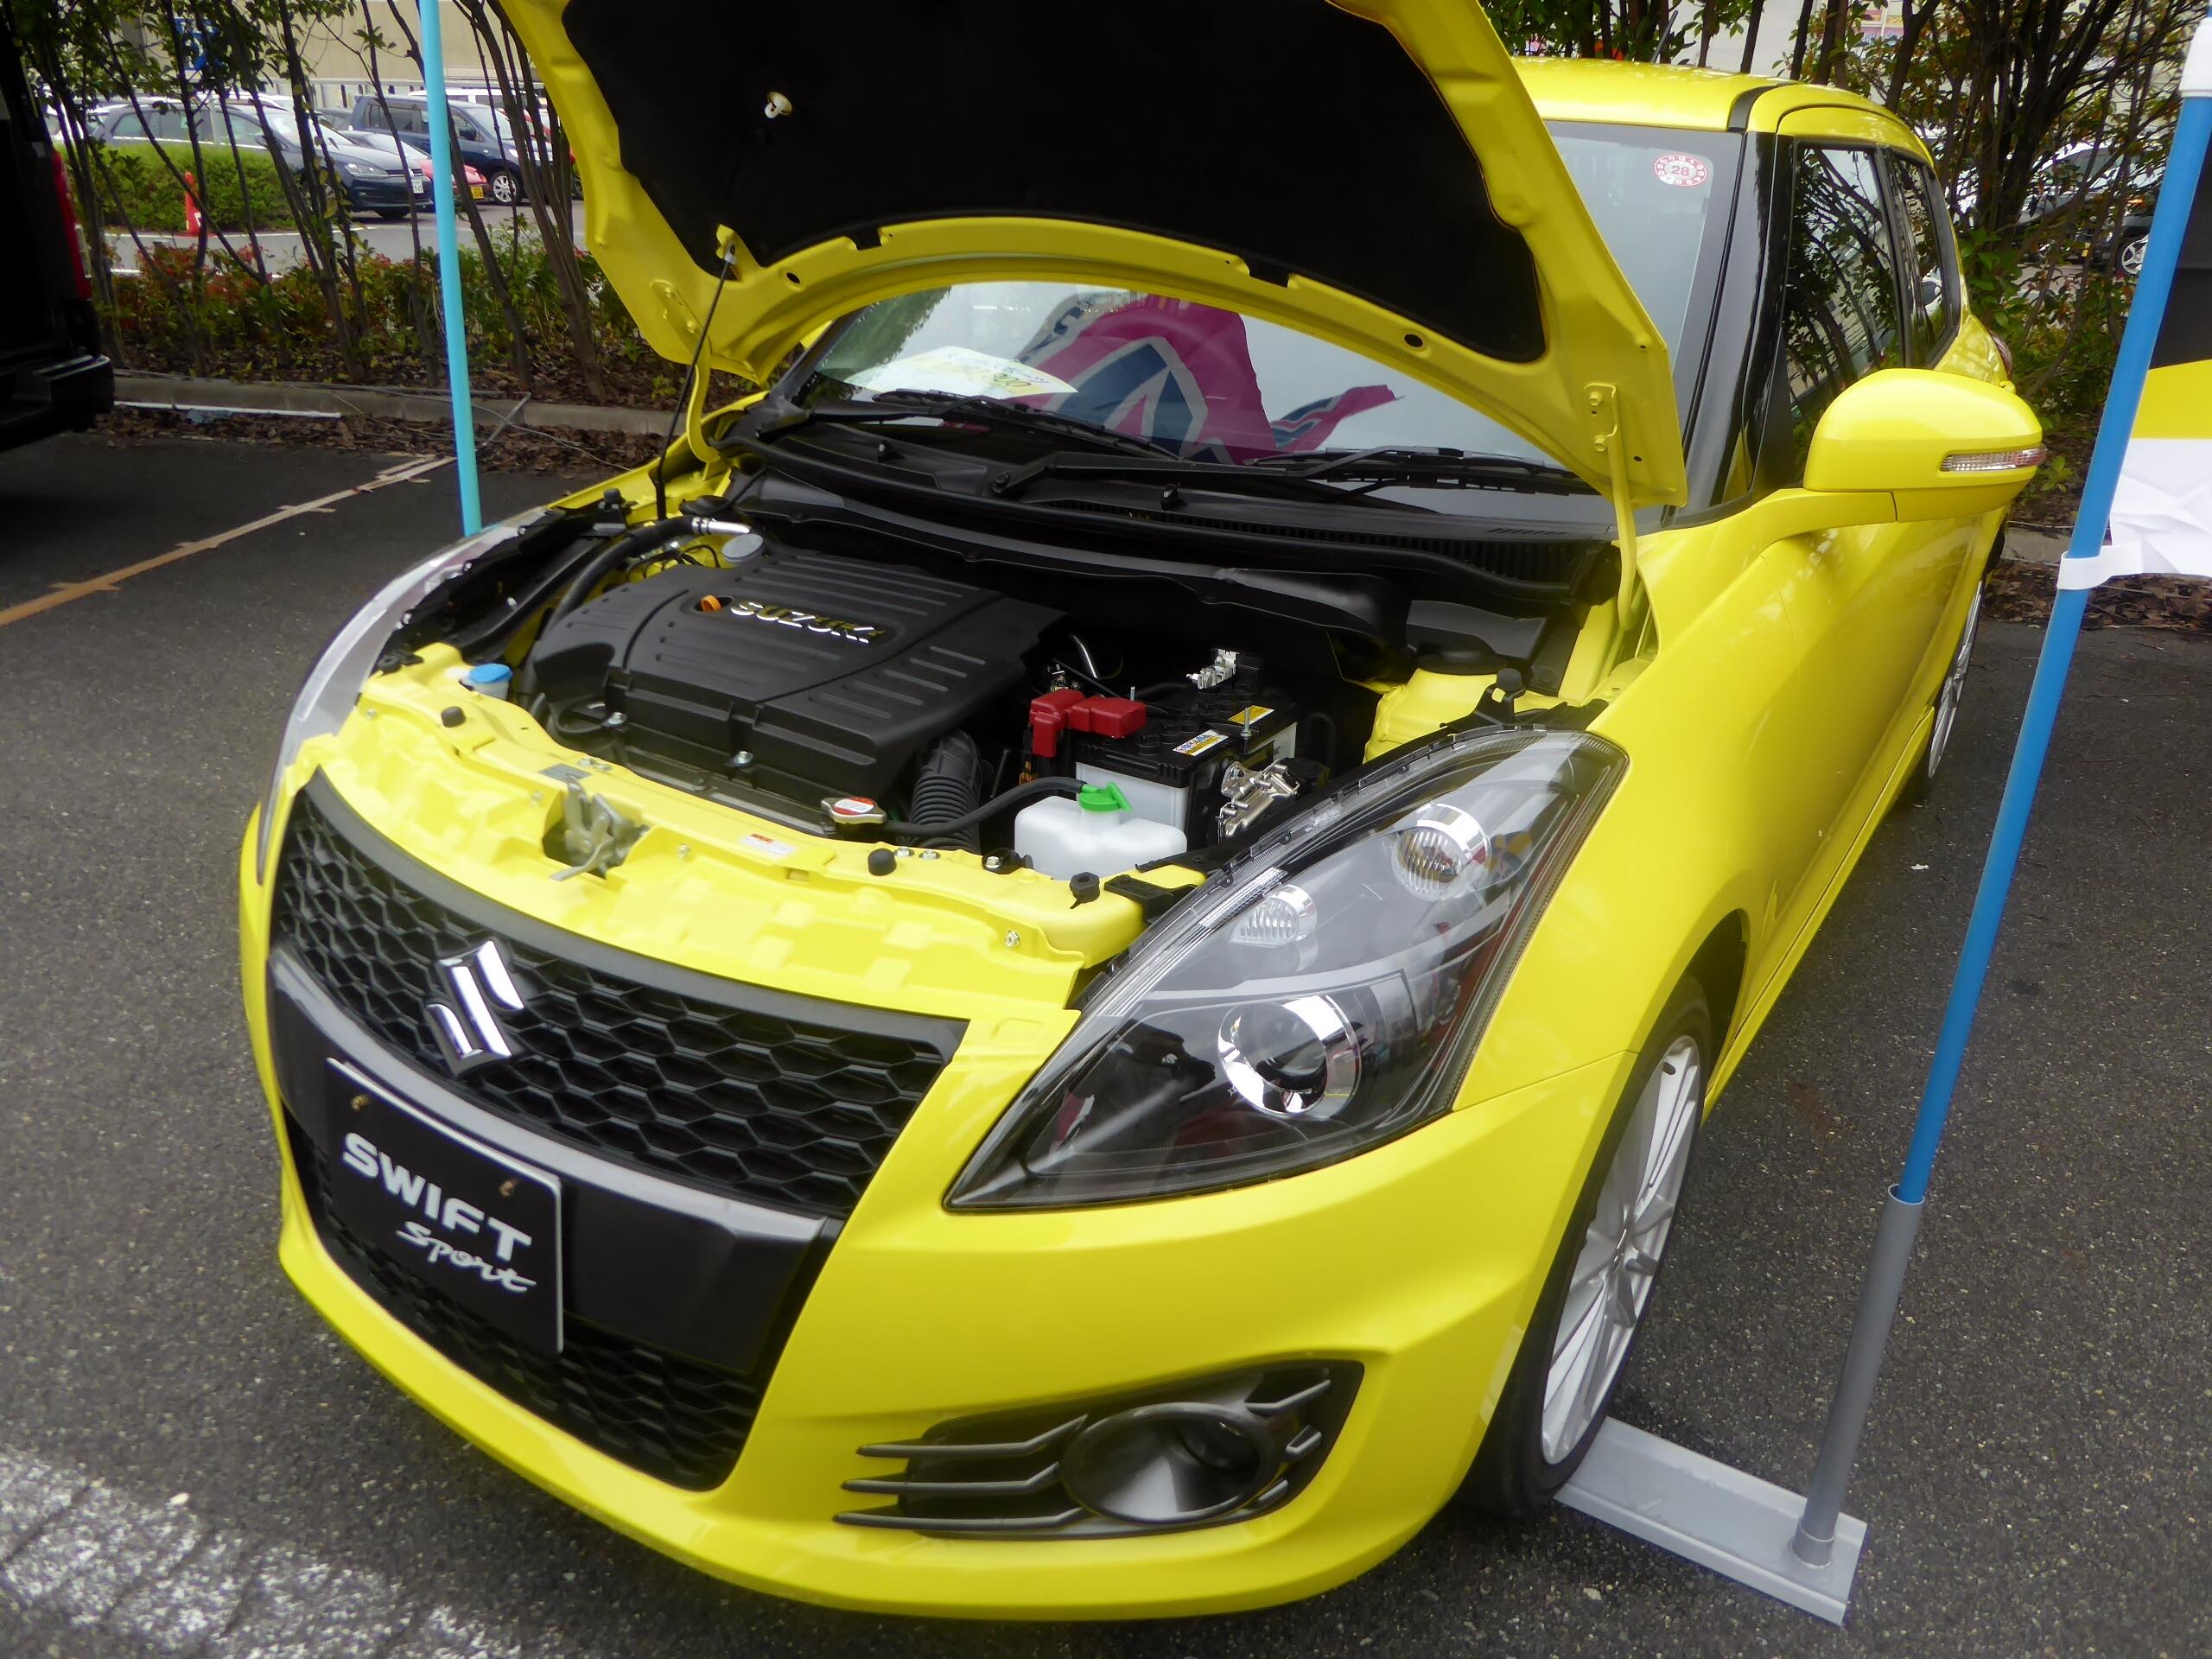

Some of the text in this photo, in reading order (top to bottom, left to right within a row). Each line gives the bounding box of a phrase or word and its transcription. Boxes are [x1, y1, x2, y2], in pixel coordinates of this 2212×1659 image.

[1671, 165, 1690, 177] 28
[730, 601, 886, 644] SUZUKI
[343, 1133, 532, 1262] SWIFT
[395, 1221, 537, 1293] Sport
